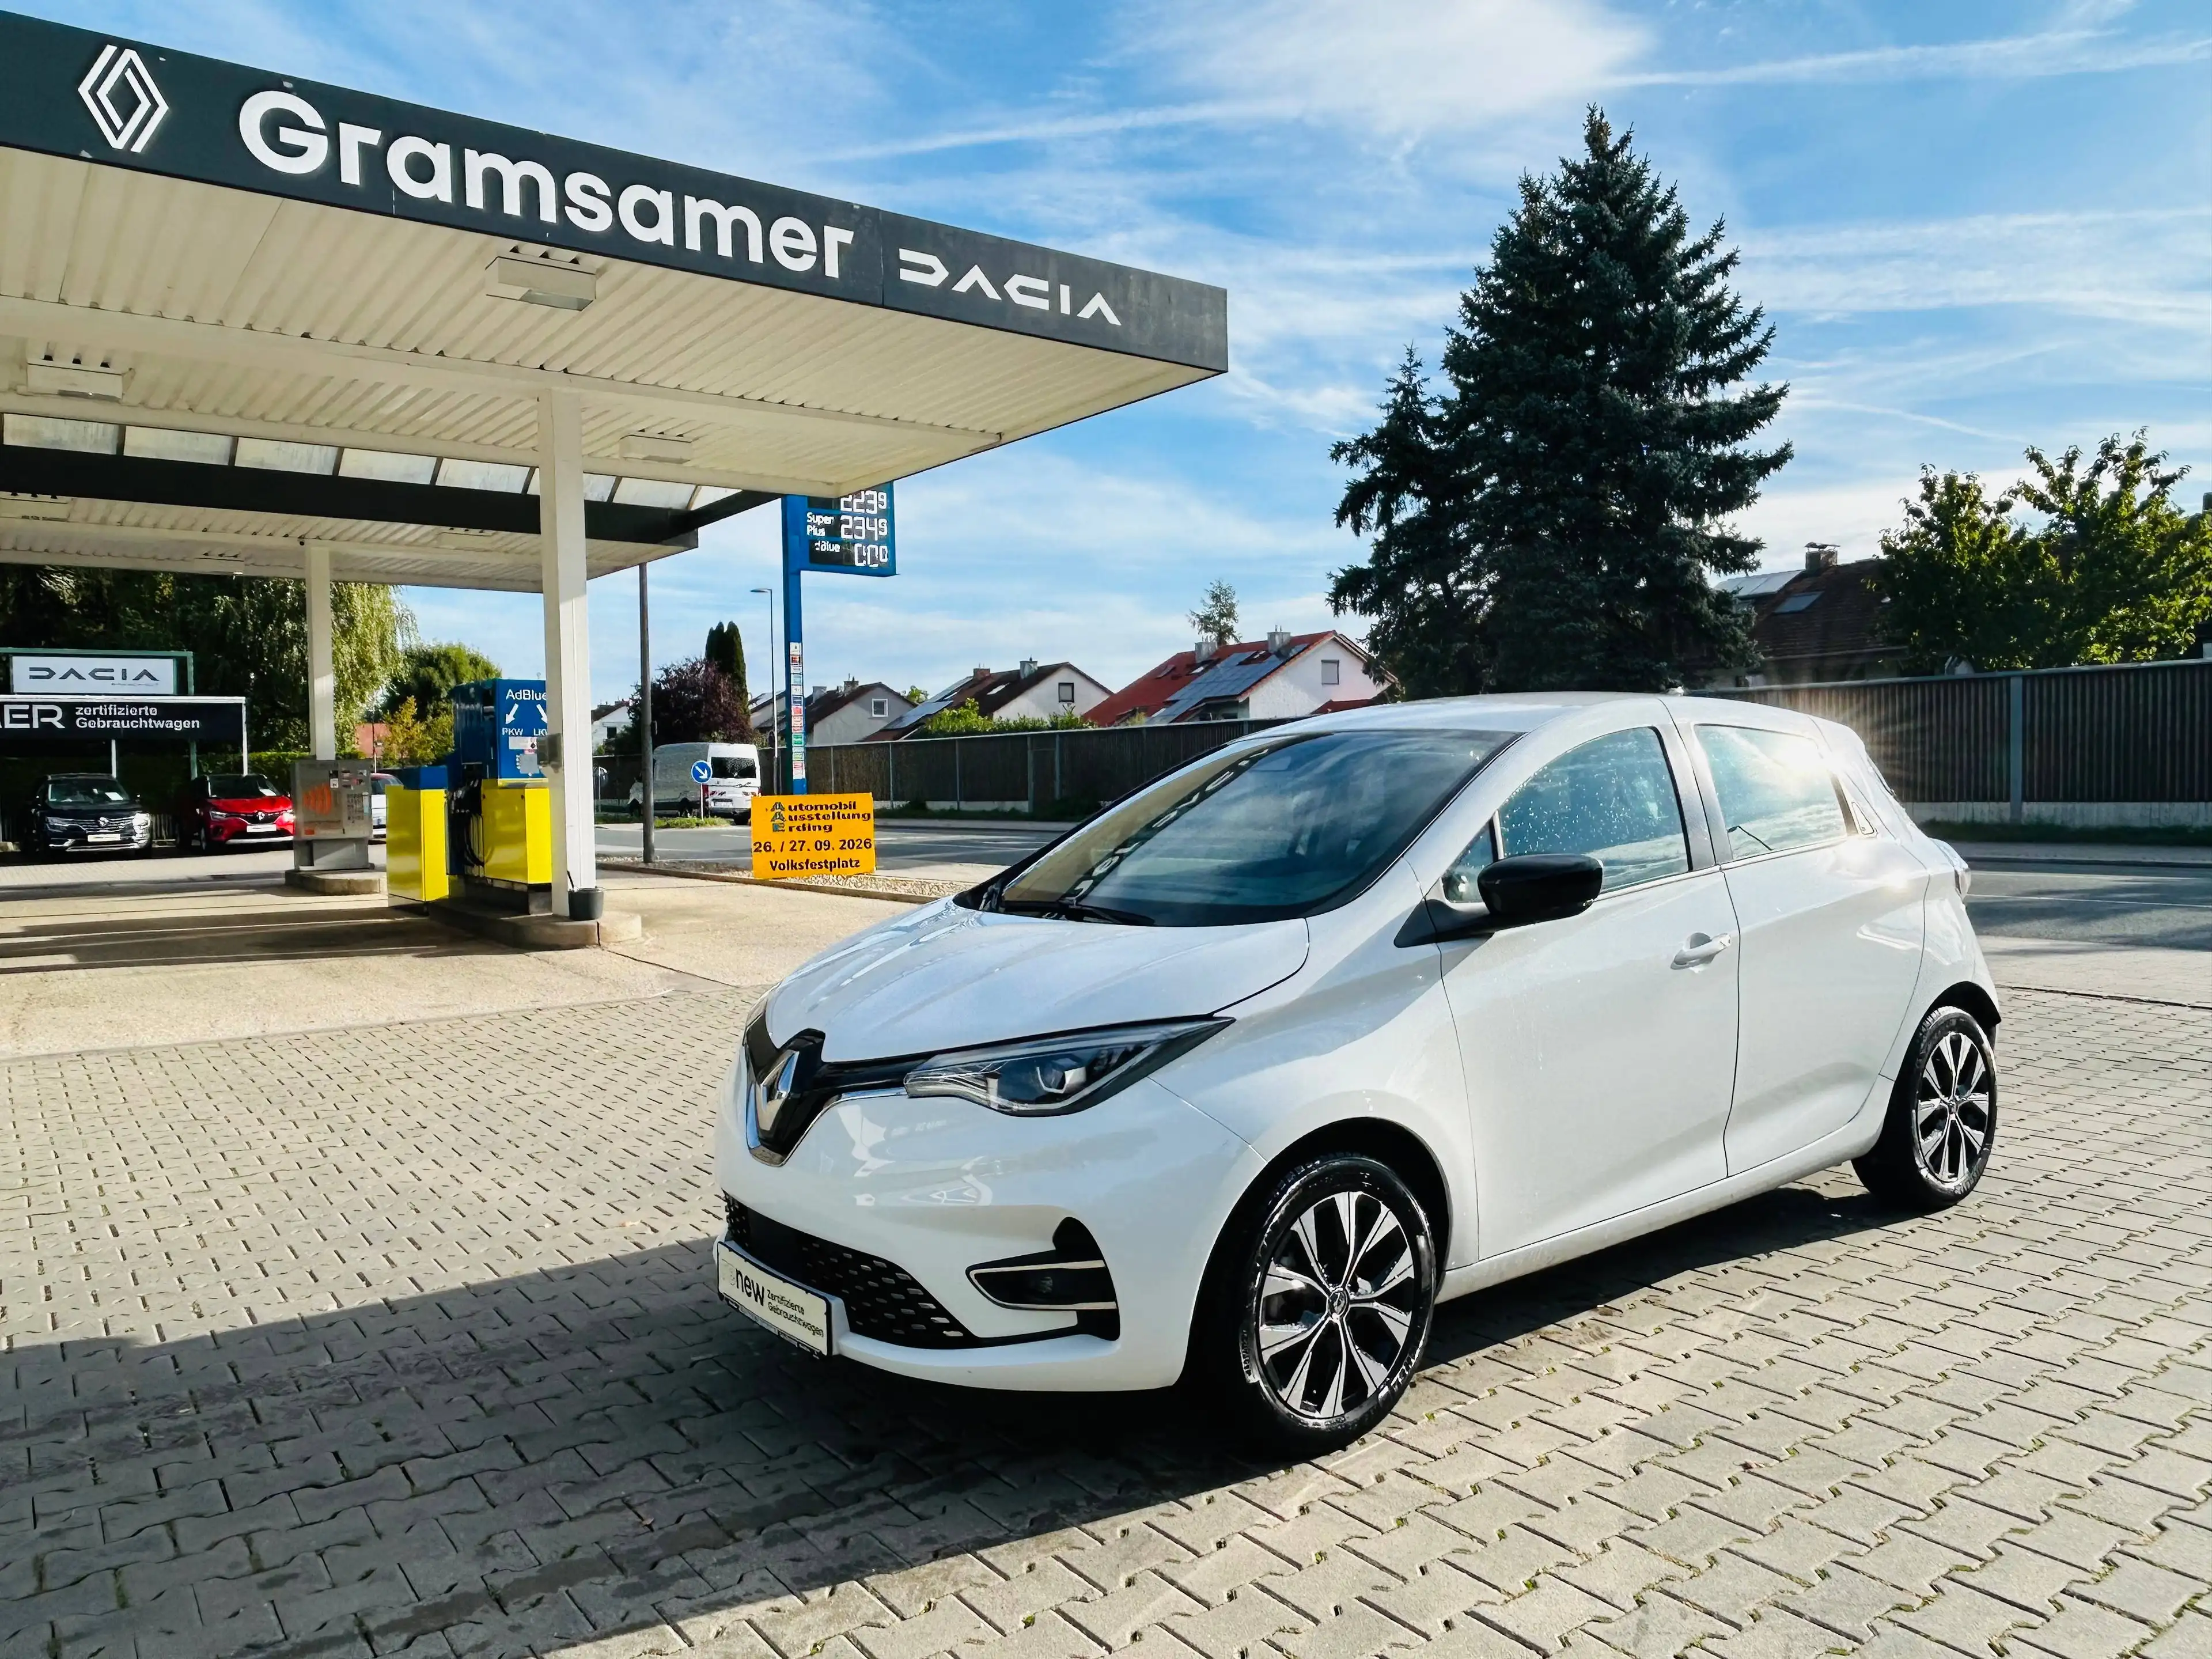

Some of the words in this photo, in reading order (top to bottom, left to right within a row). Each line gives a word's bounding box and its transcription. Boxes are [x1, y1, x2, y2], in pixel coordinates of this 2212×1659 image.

[239, 90, 854, 278] Gramsamer
[899, 248, 1122, 325] DACIA
[806, 512, 834, 525] Super
[806, 524, 825, 536] Plus
[29, 667, 160, 681] DACIA
[506, 689, 547, 700] AdBlue
[75, 704, 157, 715] zertifizierte
[0, 704, 65, 728] ER
[76, 718, 200, 730] Gebrauchtwagen
[502, 728, 523, 736] PKW
[771, 801, 856, 812] Automobil
[771, 812, 870, 821] Ausstellung
[772, 823, 832, 832] Erding
[839, 839, 872, 850] 2026
[770, 858, 860, 872] Volksfestplatz
[736, 1268, 764, 1306] new
